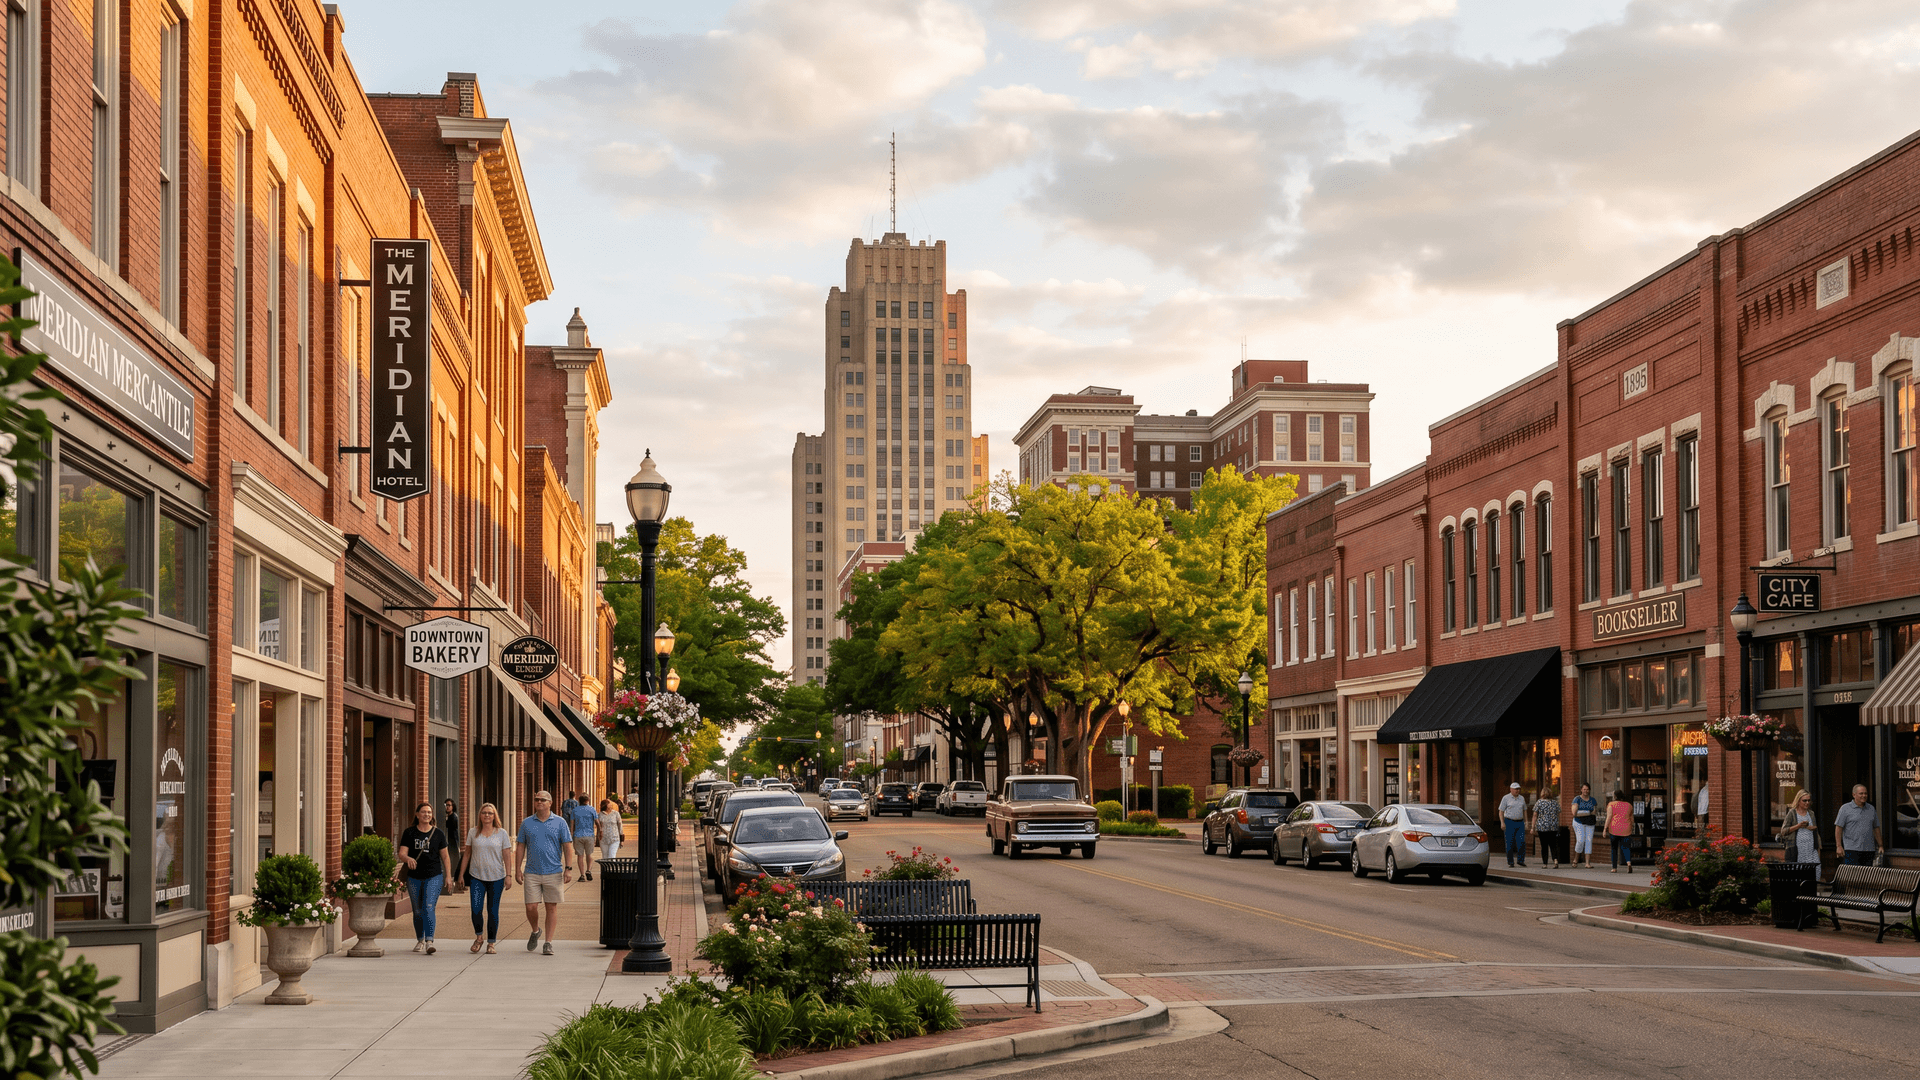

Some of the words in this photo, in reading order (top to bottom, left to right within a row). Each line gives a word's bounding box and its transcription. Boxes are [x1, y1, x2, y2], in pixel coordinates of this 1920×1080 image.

[385, 248, 415, 258] THE
[29, 282, 109, 380] MERIDIAN
[113, 347, 191, 441] MERCANTILE
[386, 264, 413, 470] MERIDIAN
[1625, 367, 1647, 395] 1895
[377, 477, 423, 486] HOTEL
[1769, 578, 1811, 592] CITY
[1766, 594, 1814, 607] CAFE
[1597, 600, 1678, 635] BOOKSELLER
[410, 630, 483, 643] DOWNTOWN
[413, 646, 481, 663] BAKERY
